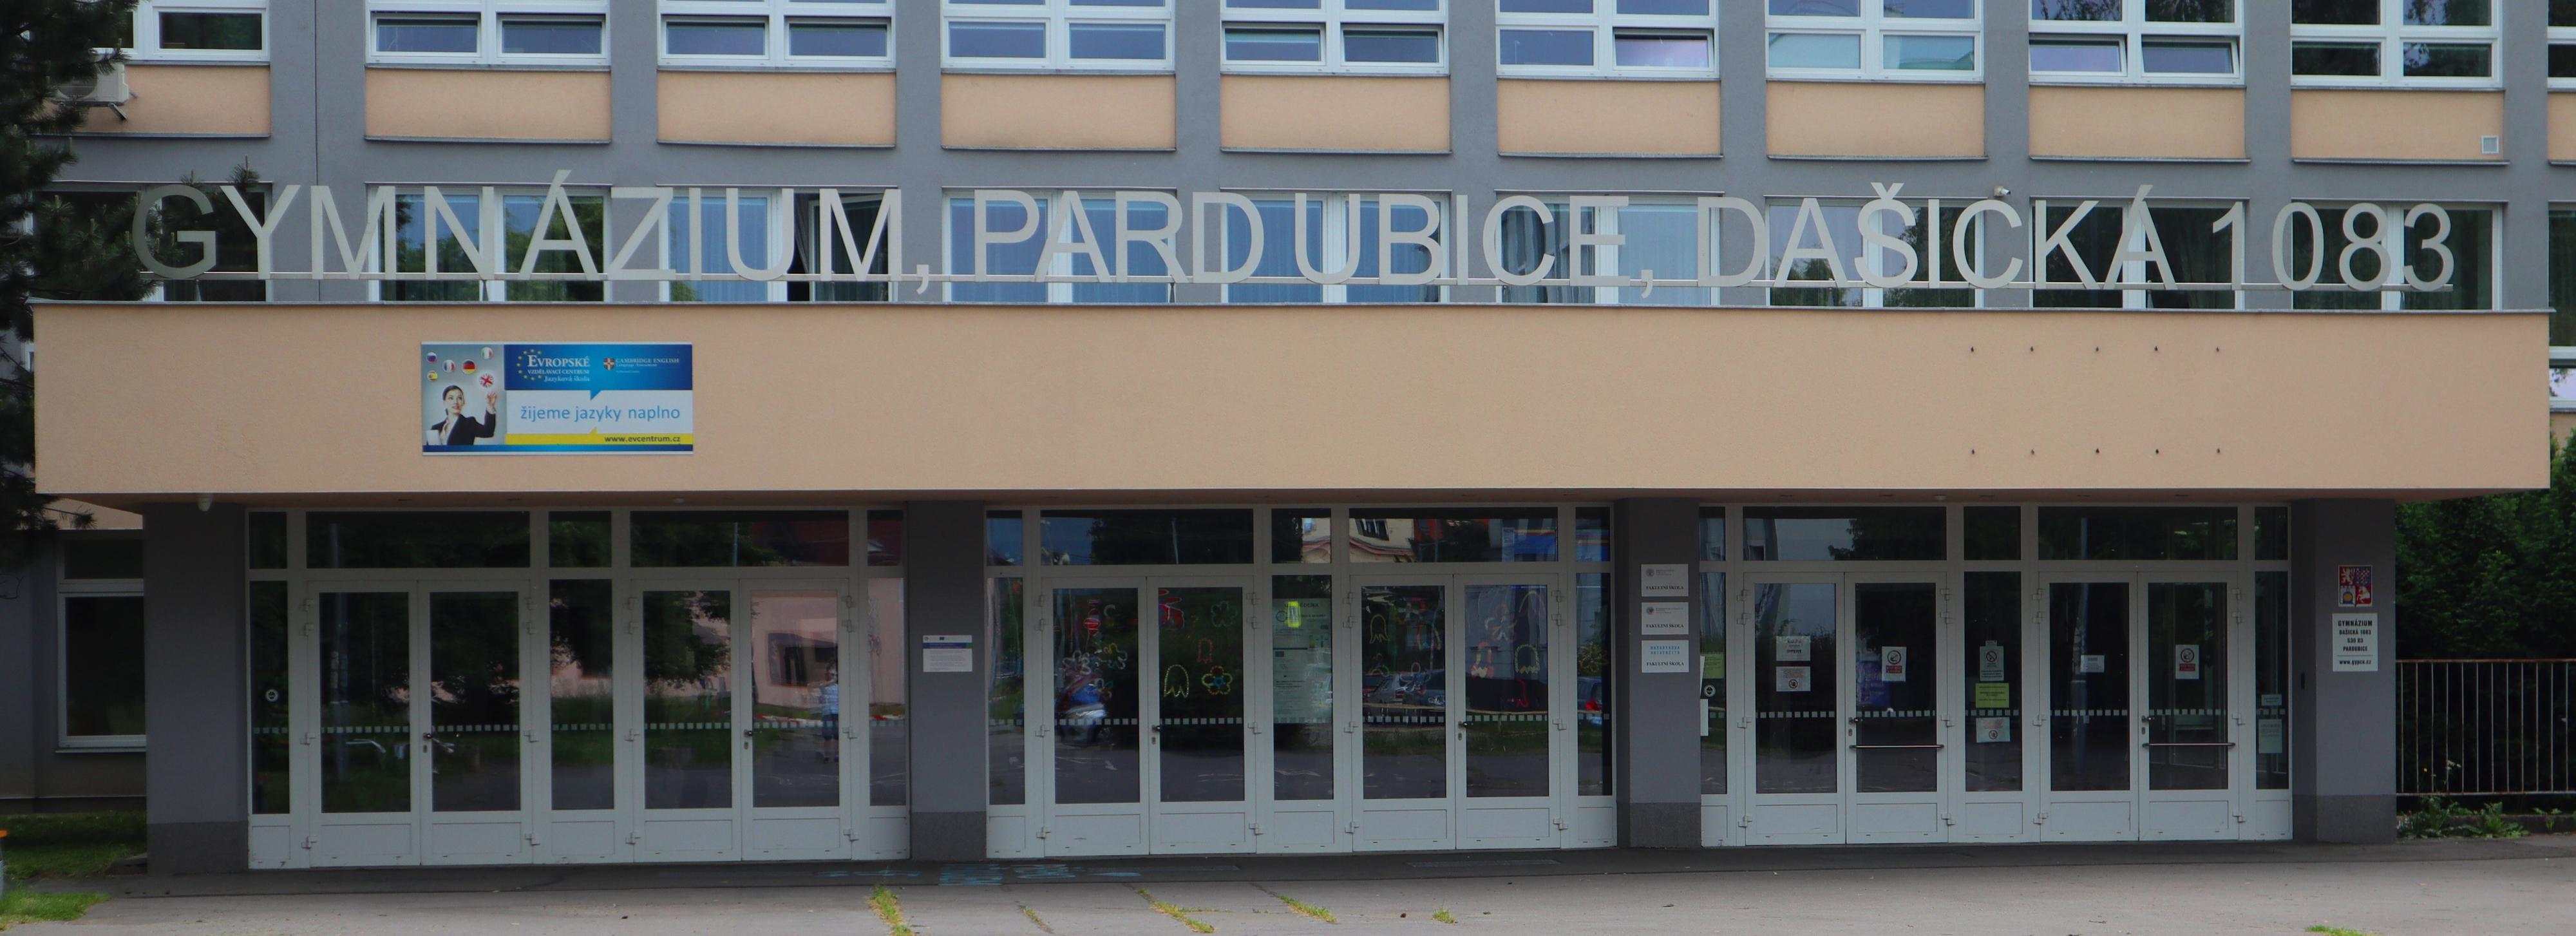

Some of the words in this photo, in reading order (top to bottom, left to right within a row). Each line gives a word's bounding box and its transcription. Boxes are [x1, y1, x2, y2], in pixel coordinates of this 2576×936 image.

[131, 169, 929, 294] GYMNÁZIUM,
[1697, 182, 2177, 290] DAŠICKÁ
[2213, 202, 2454, 291] 1083
[520, 406, 570, 422] žijeme
[574, 406, 621, 422] jazyky
[628, 405, 680, 422] naplno
